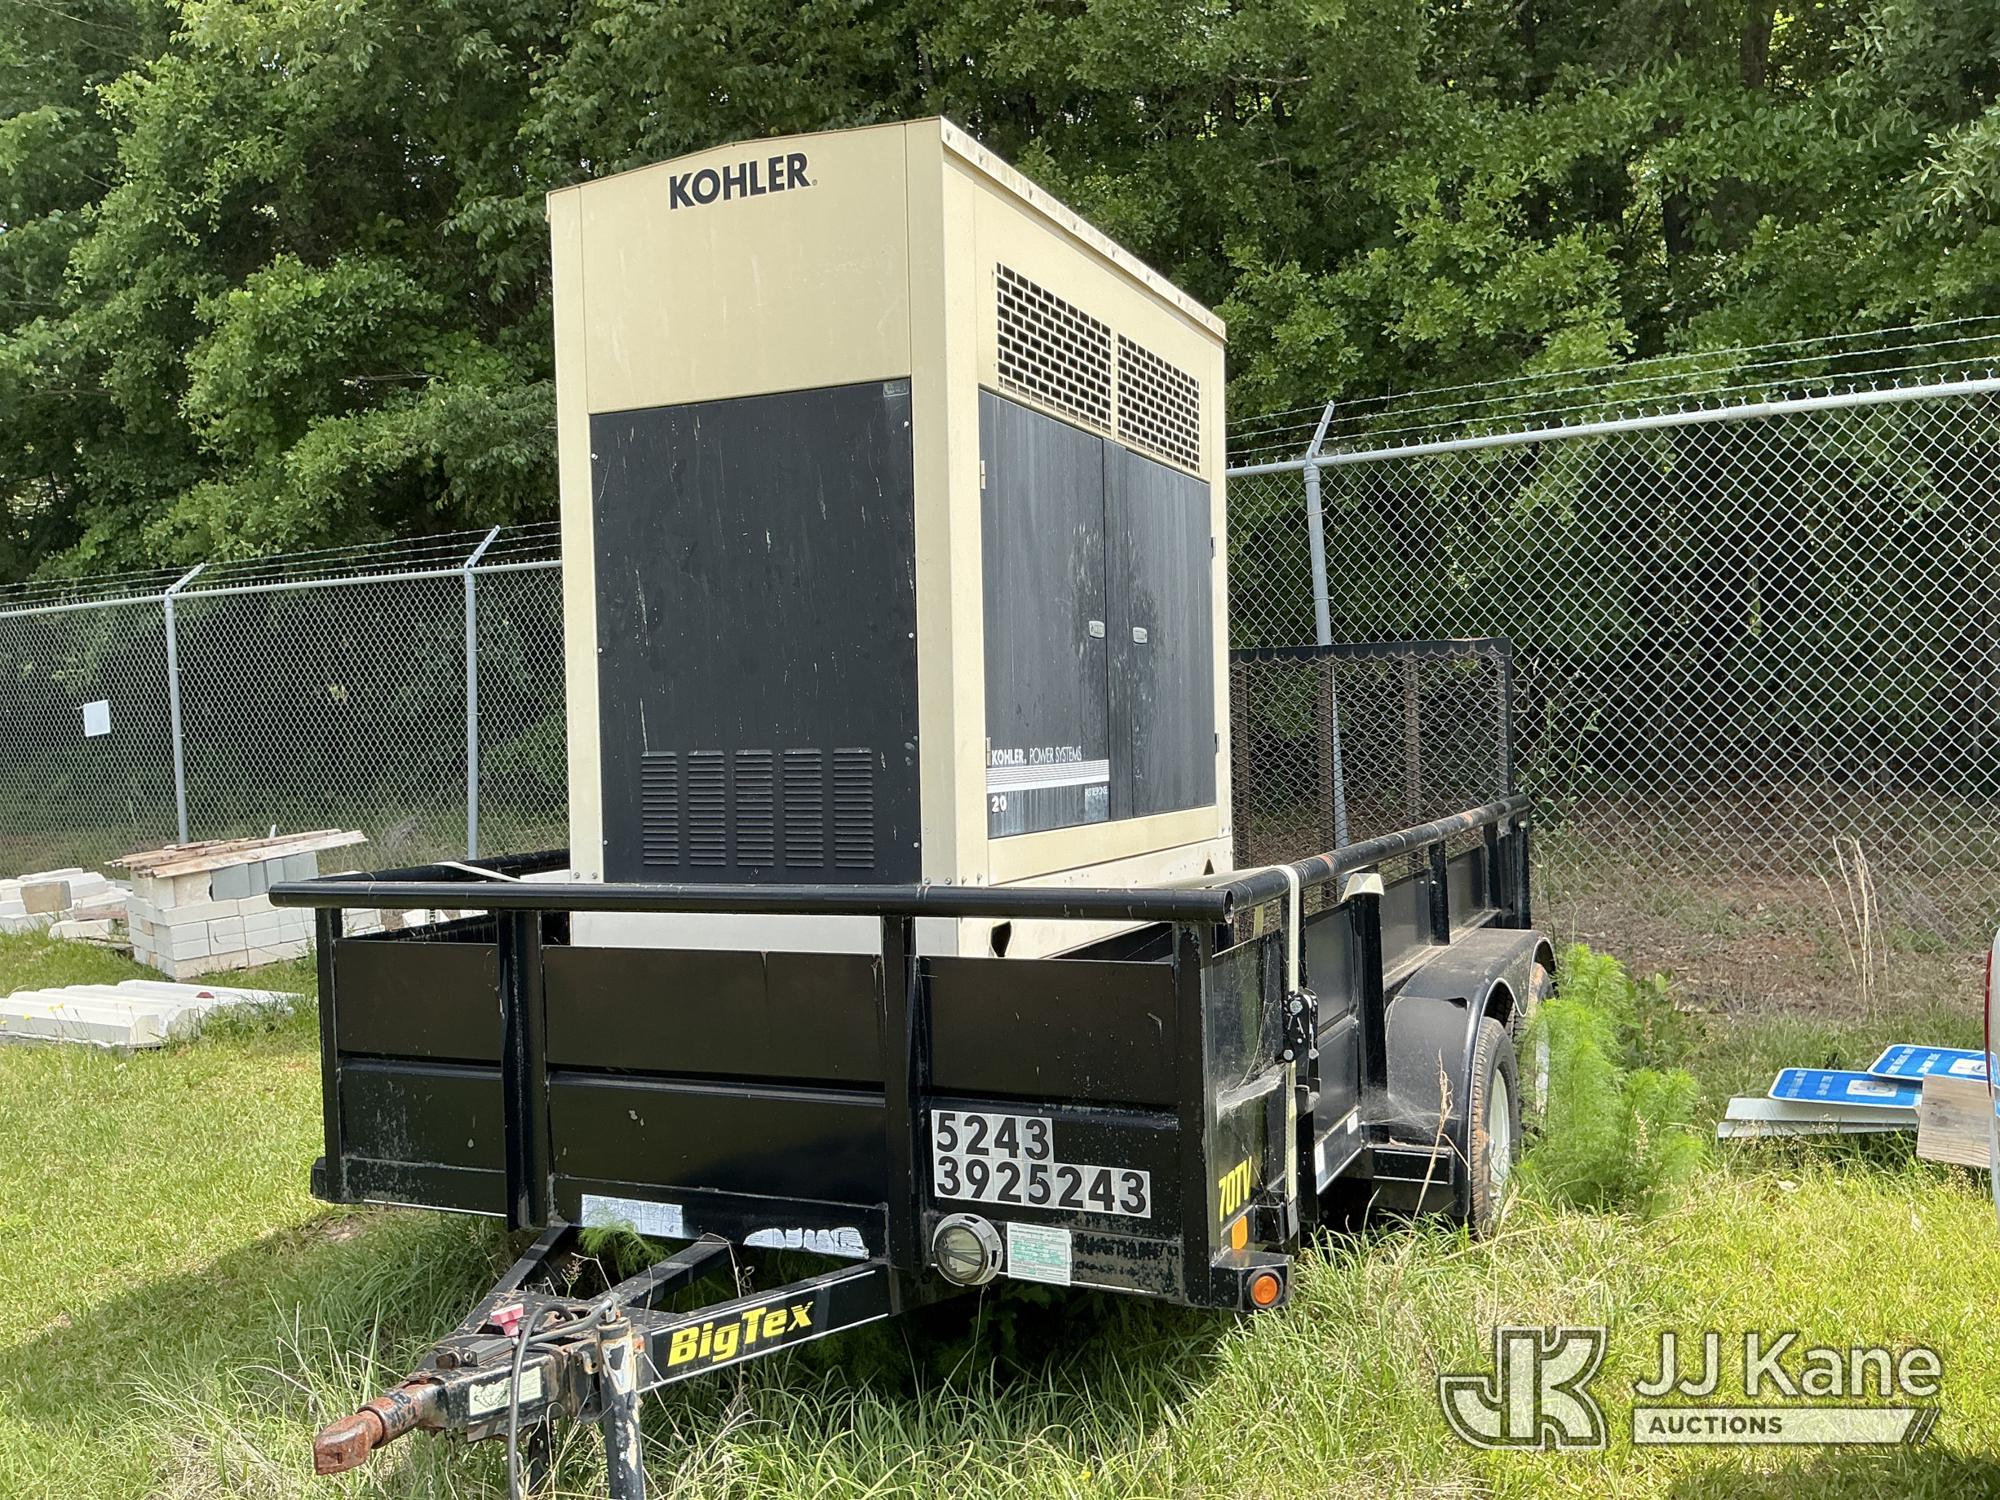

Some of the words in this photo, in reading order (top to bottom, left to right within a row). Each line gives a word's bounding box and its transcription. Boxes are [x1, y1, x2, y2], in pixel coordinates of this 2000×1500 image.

[669, 152, 811, 210] KOHLER
[1029, 747, 1054, 764] POWER
[1055, 746, 1082, 762] SYSTEMS
[991, 795, 1008, 813] 20
[936, 1112, 1051, 1160] 5243
[937, 1155, 1147, 1214] 3925243
[1219, 1156, 1252, 1222] 70TV
